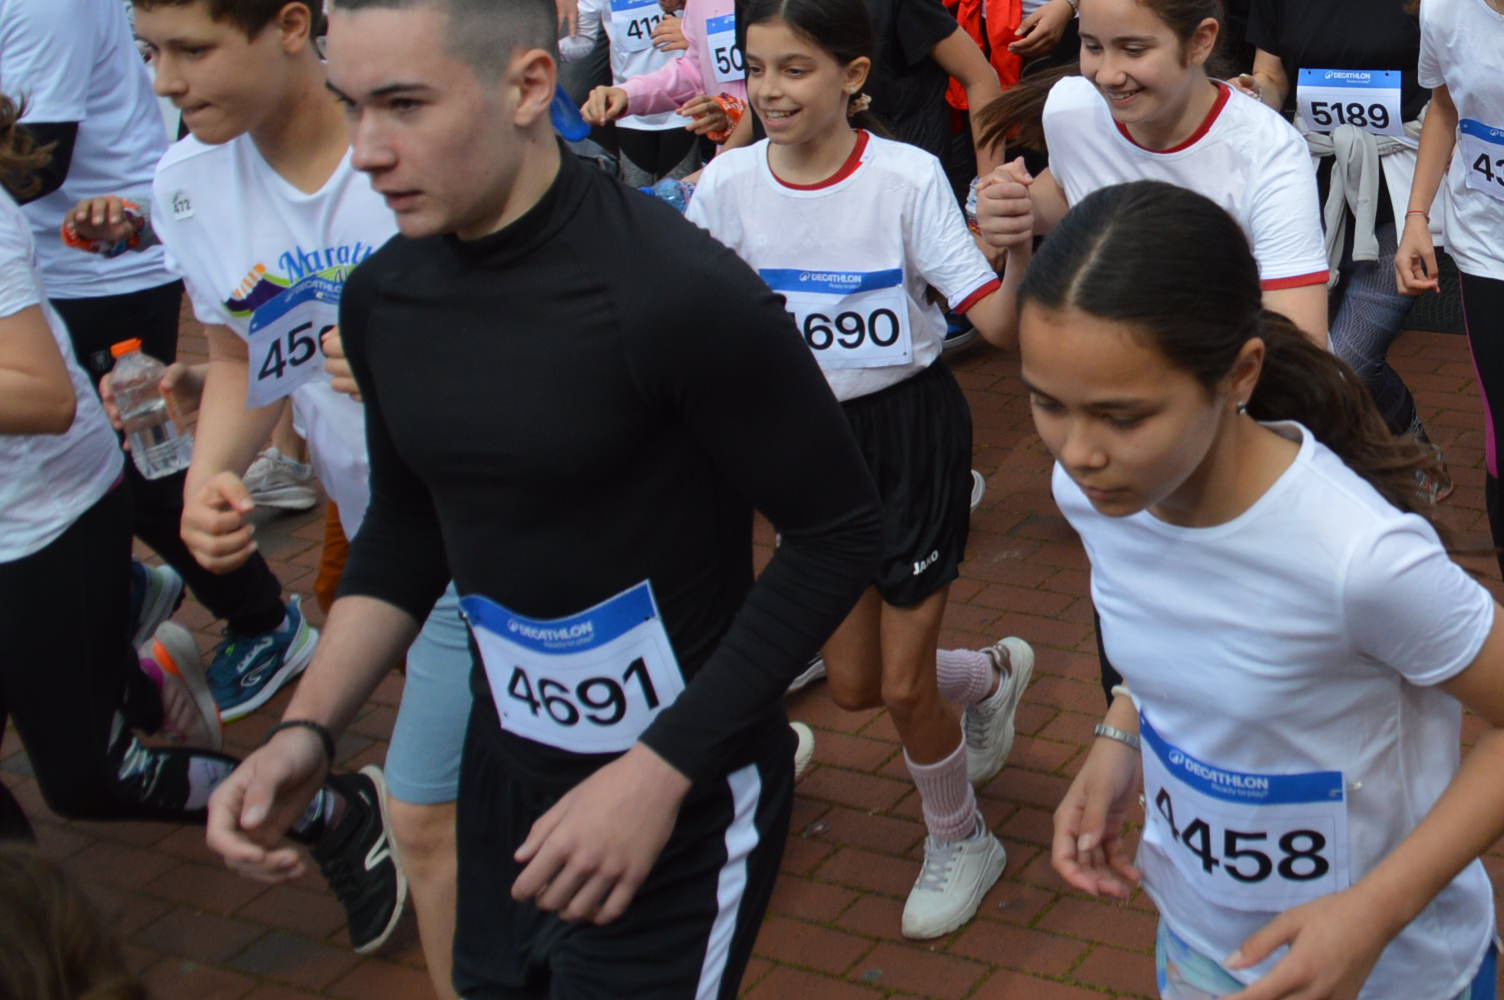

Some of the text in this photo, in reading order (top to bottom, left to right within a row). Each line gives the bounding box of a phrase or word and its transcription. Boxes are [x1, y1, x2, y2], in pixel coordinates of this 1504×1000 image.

[1333, 71, 1371, 80] DECATHLON
[1310, 101, 1391, 129] 5189
[811, 273, 862, 284] DECATHLON
[800, 307, 900, 350] 690
[519, 619, 593, 641] DECATHLON
[508, 655, 660, 727] 4691
[1184, 756, 1269, 791] DECATHLON
[1155, 785, 1330, 885] 4458
